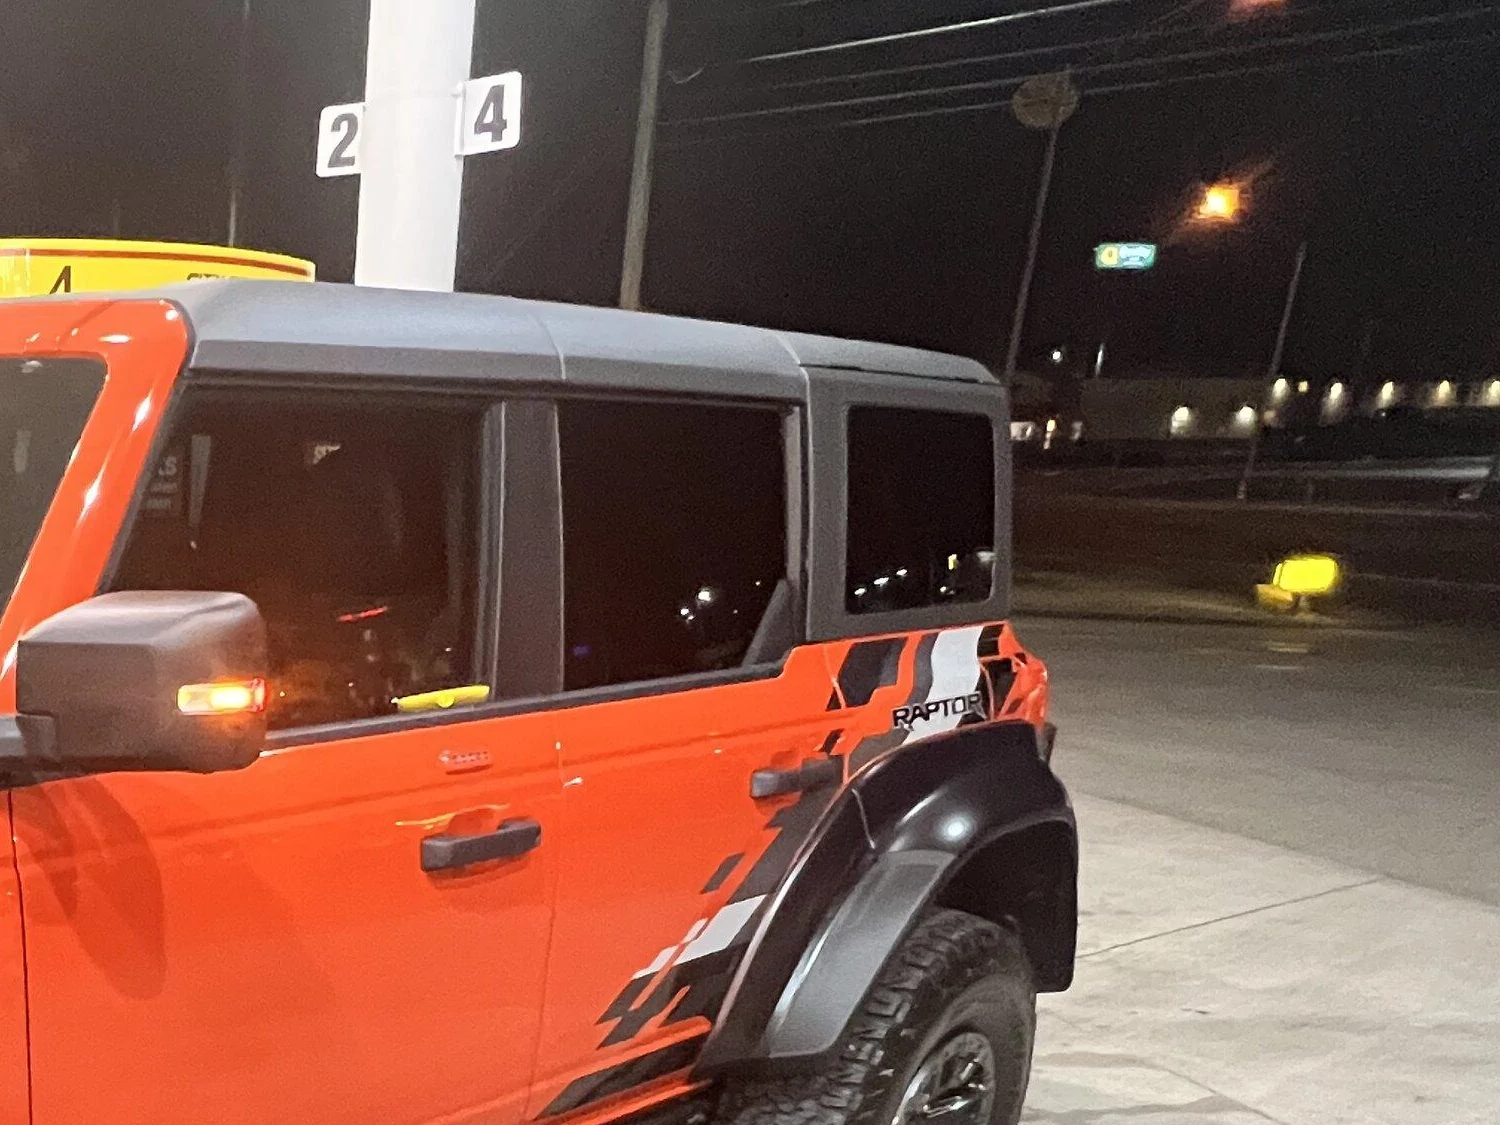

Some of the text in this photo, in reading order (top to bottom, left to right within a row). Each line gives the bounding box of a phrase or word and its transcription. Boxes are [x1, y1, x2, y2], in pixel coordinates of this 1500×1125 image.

[328, 112, 358, 168] 2
[474, 84, 507, 143] 4
[892, 691, 988, 731] RAPTOR
